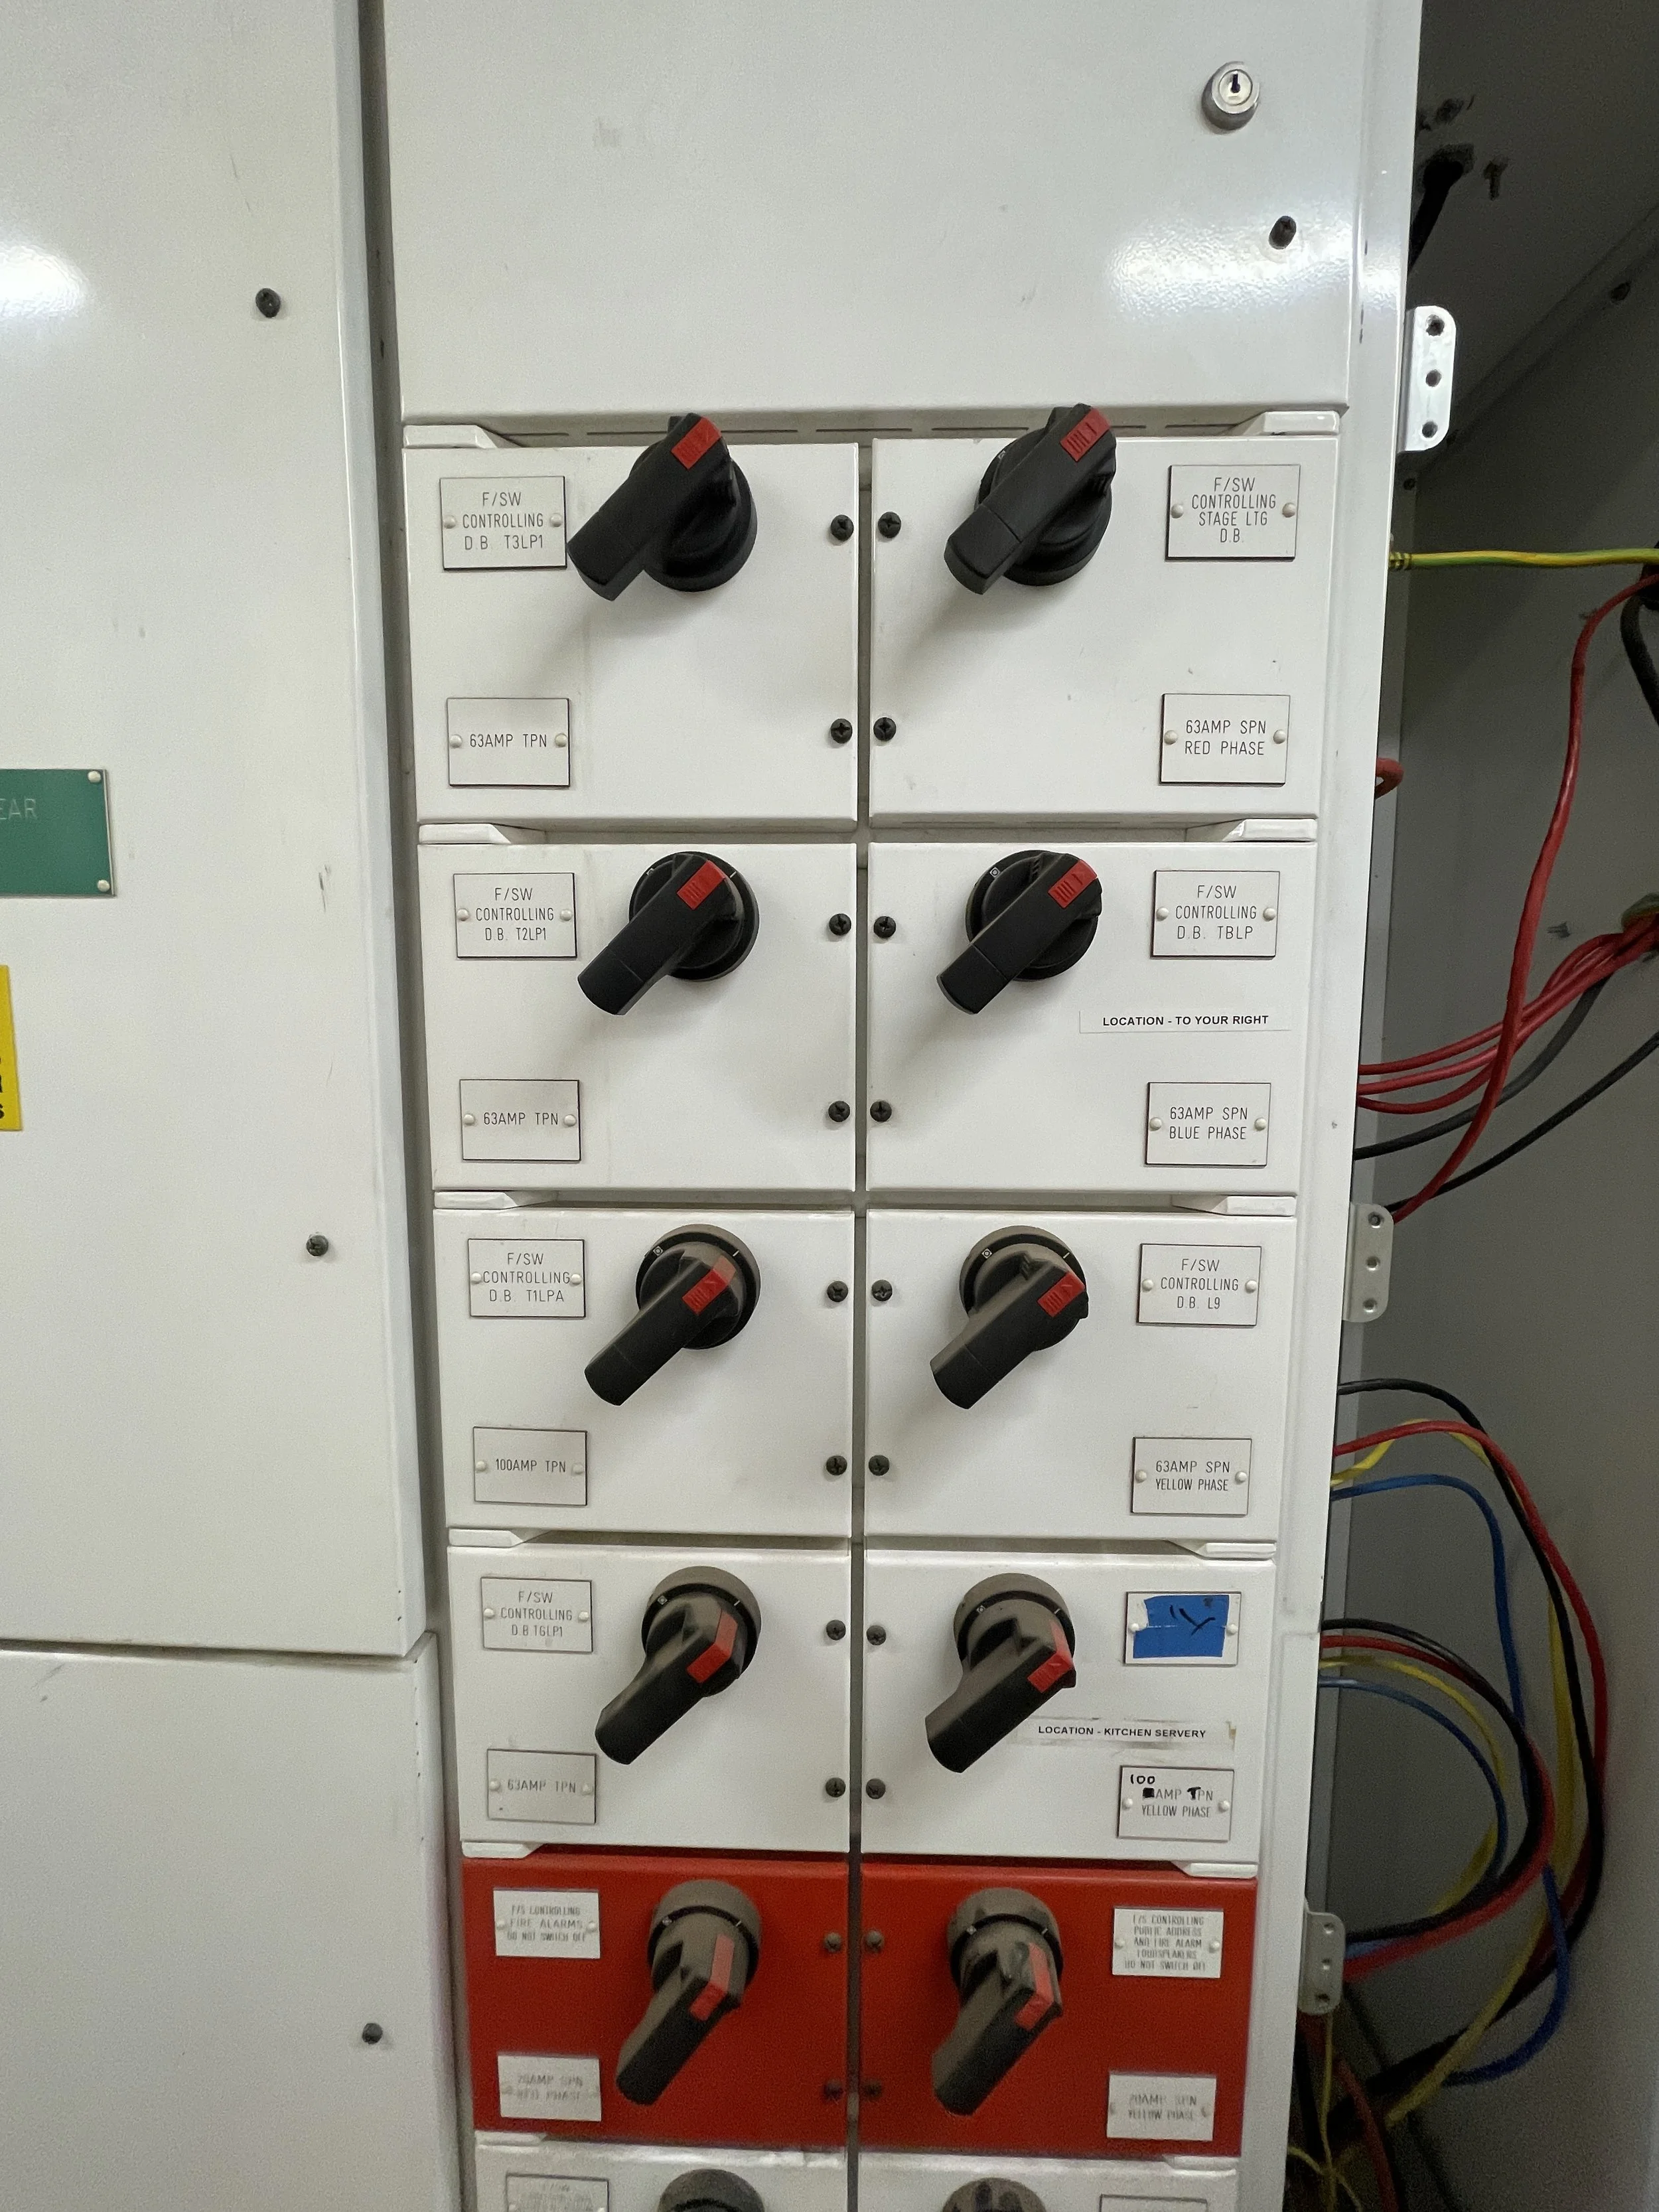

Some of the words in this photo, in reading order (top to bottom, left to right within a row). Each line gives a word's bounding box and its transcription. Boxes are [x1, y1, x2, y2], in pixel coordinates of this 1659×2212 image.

[1214, 477, 1255, 492] F/SW
[482, 492, 521, 506] F/SW
[1192, 494, 1276, 509] CONTROLLING
[463, 513, 543, 528] CONTROLLING
[1198, 511, 1238, 526] STAGE
[1246, 511, 1267, 526] LTG
[504, 534, 543, 549] T3LP1
[1186, 719, 1231, 734] 63AMP
[1240, 720, 1266, 734] SPN
[470, 733, 513, 747] 63AMP
[523, 733, 547, 747] TPN
[1185, 741, 1210, 755] RED
[1221, 741, 1265, 755] PHASE
[495, 888, 532, 901] F/SW
[1198, 885, 1236, 899] F/SW
[476, 907, 554, 921] CONTROLLING
[1176, 905, 1256, 919] CONTROLLING
[516, 928, 546, 940] T2LP1
[1217, 926, 1253, 939] TBLP
[1103, 1017, 1164, 1025] LOCATION
[1175, 1016, 1191, 1025] TO
[1195, 1015, 1228, 1025] YOUR
[1232, 1015, 1269, 1024] RIGHT
[484, 1112, 526, 1125] 63AMP
[535, 1112, 558, 1125] TPN
[1170, 1106, 1213, 1120] 63AMP
[1222, 1107, 1248, 1120] SPN
[1169, 1126, 1200, 1139] BLUE
[1208, 1126, 1247, 1140] PHASE
[507, 1252, 543, 1265] F/SW
[1182, 1258, 1220, 1272] F/SW
[483, 1271, 570, 1284] CONTROLLING
[1161, 1277, 1238, 1291] CONTROLLING
[526, 1290, 564, 1302] T1LPA
[1208, 1297, 1220, 1309] L9
[496, 1458, 537, 1471] 100AMP
[545, 1460, 566, 1473] TPN
[1156, 1460, 1197, 1473] 63AMP
[1205, 1461, 1230, 1473] SPN
[1155, 1478, 1192, 1491] YELLOW
[1198, 1479, 1228, 1491] PHASE
[518, 1591, 553, 1603] F/SW
[500, 1607, 572, 1621] CONTROLLING
[1038, 1726, 1094, 1735] LOCATION
[1104, 1728, 1152, 1737] KITCHEN
[1155, 1729, 1206, 1738] SERVERY
[1130, 1774, 1155, 1784] 100
[1142, 1787, 1182, 1800] AMP
[1141, 1805, 1177, 1816] YELLOW
[1183, 1805, 1211, 1817] PHASE
